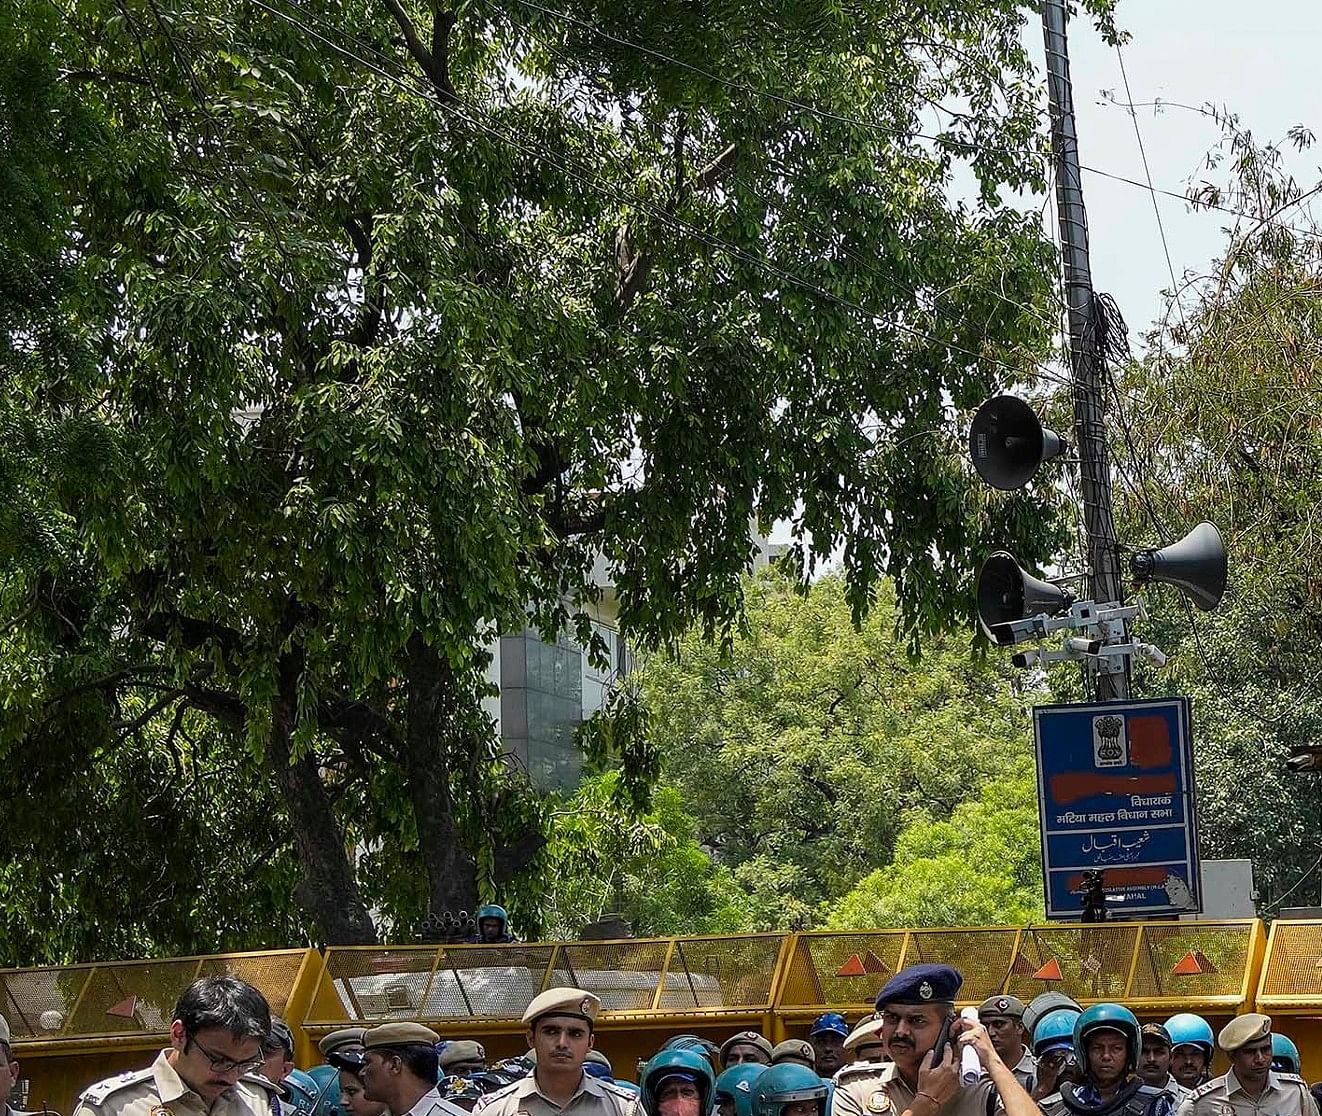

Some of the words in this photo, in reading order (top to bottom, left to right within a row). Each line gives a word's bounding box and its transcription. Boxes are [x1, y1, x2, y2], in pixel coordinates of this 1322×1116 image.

[1131, 795, 1172, 807] विधायक
[1056, 812, 1087, 824] मटिया
[1117, 808, 1148, 821] विधान
[1150, 808, 1173, 819] सभा
